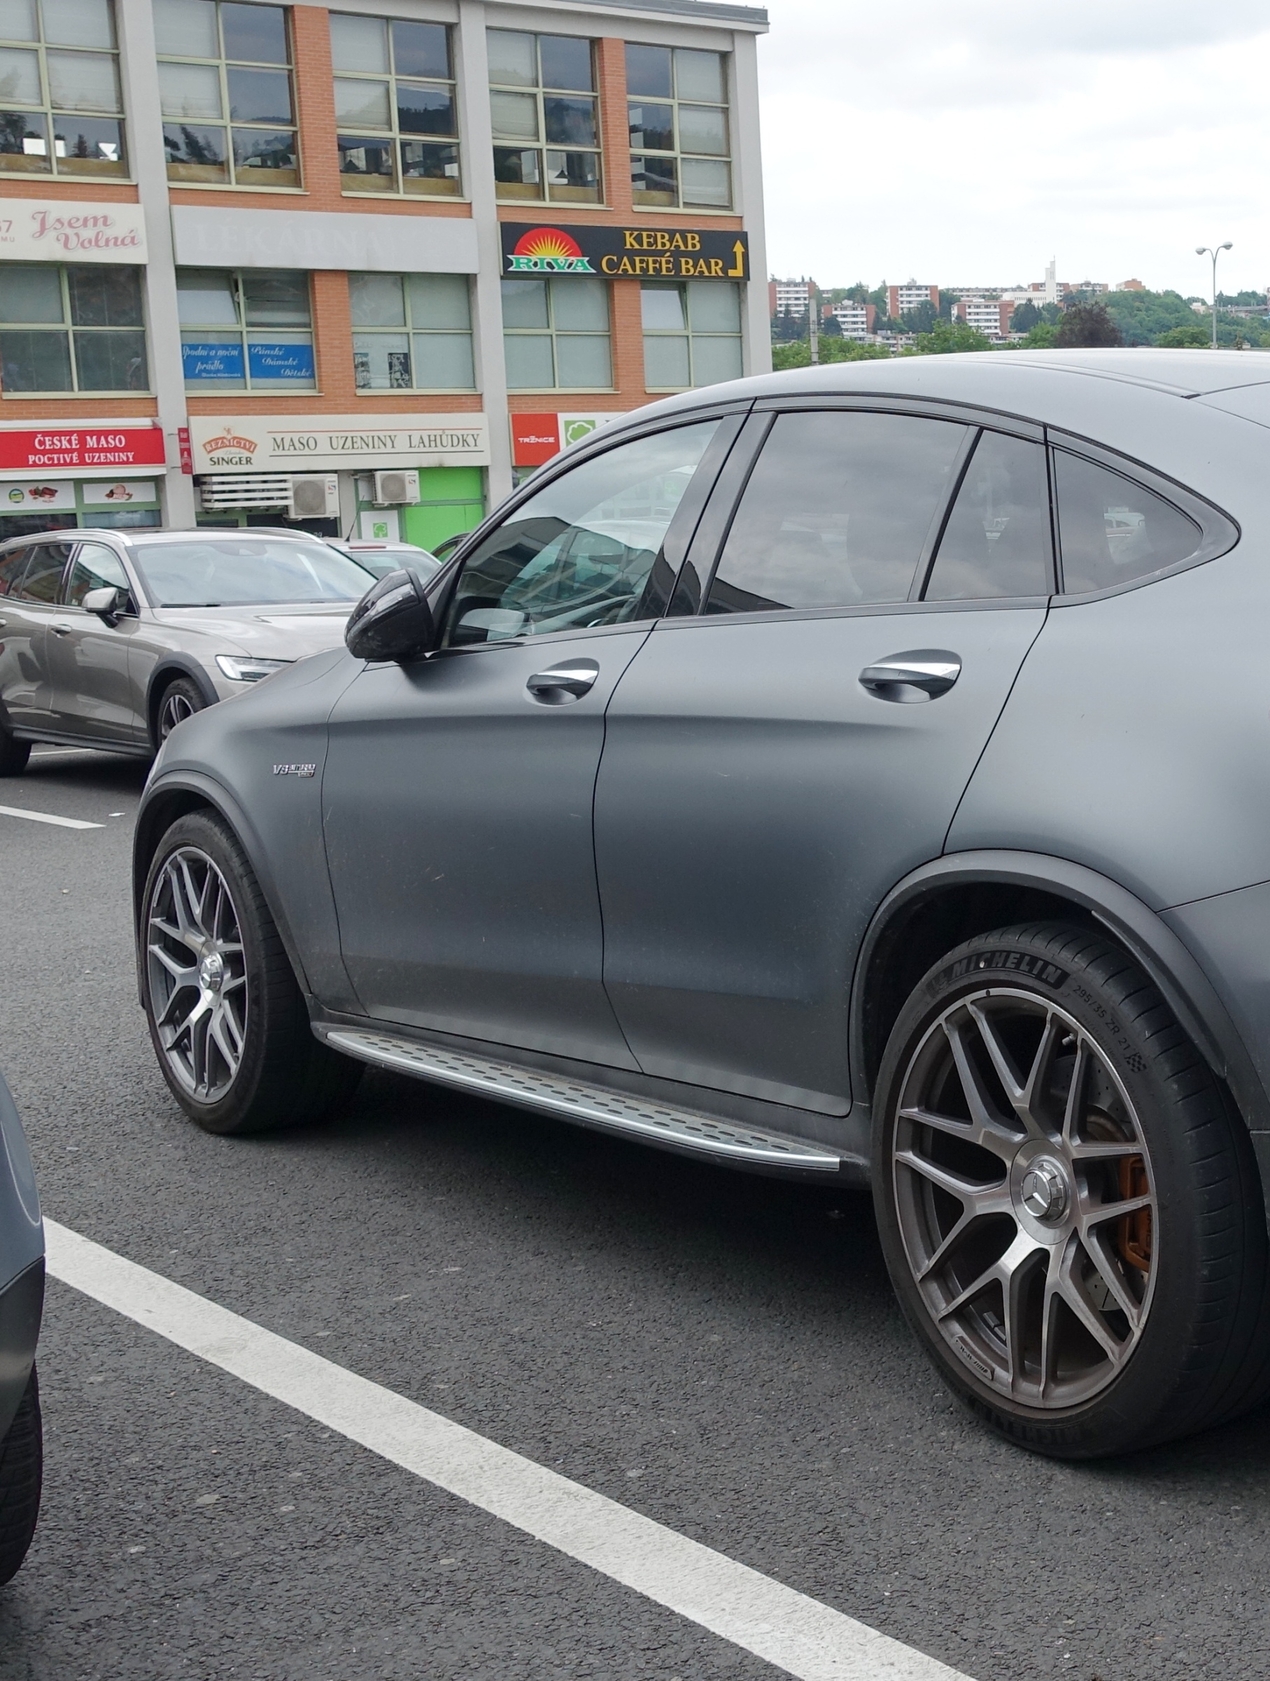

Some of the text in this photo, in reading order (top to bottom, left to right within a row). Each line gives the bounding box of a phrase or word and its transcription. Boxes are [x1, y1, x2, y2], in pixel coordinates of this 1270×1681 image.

[31, 210, 113, 239] Jsem
[56, 229, 140, 251] Volná
[622, 230, 701, 251] KEBAB
[512, 256, 590, 272] RIVA
[600, 252, 725, 277] CAFFÉ BAR
[34, 433, 126, 450] ČESKÉ MASO
[272, 430, 480, 452] MASO UZENINY LAHŮDKY
[518, 436, 555, 444] TRŽNICE
[28, 451, 135, 465] POCTIVÉ UZENINY
[209, 456, 253, 466] SINGER
[952, 950, 1062, 984] MICHELIN
[1072, 984, 1107, 1018] 295/35
[1105, 1018, 1120, 1036] ZR
[1118, 1037, 1131, 1051] 21
